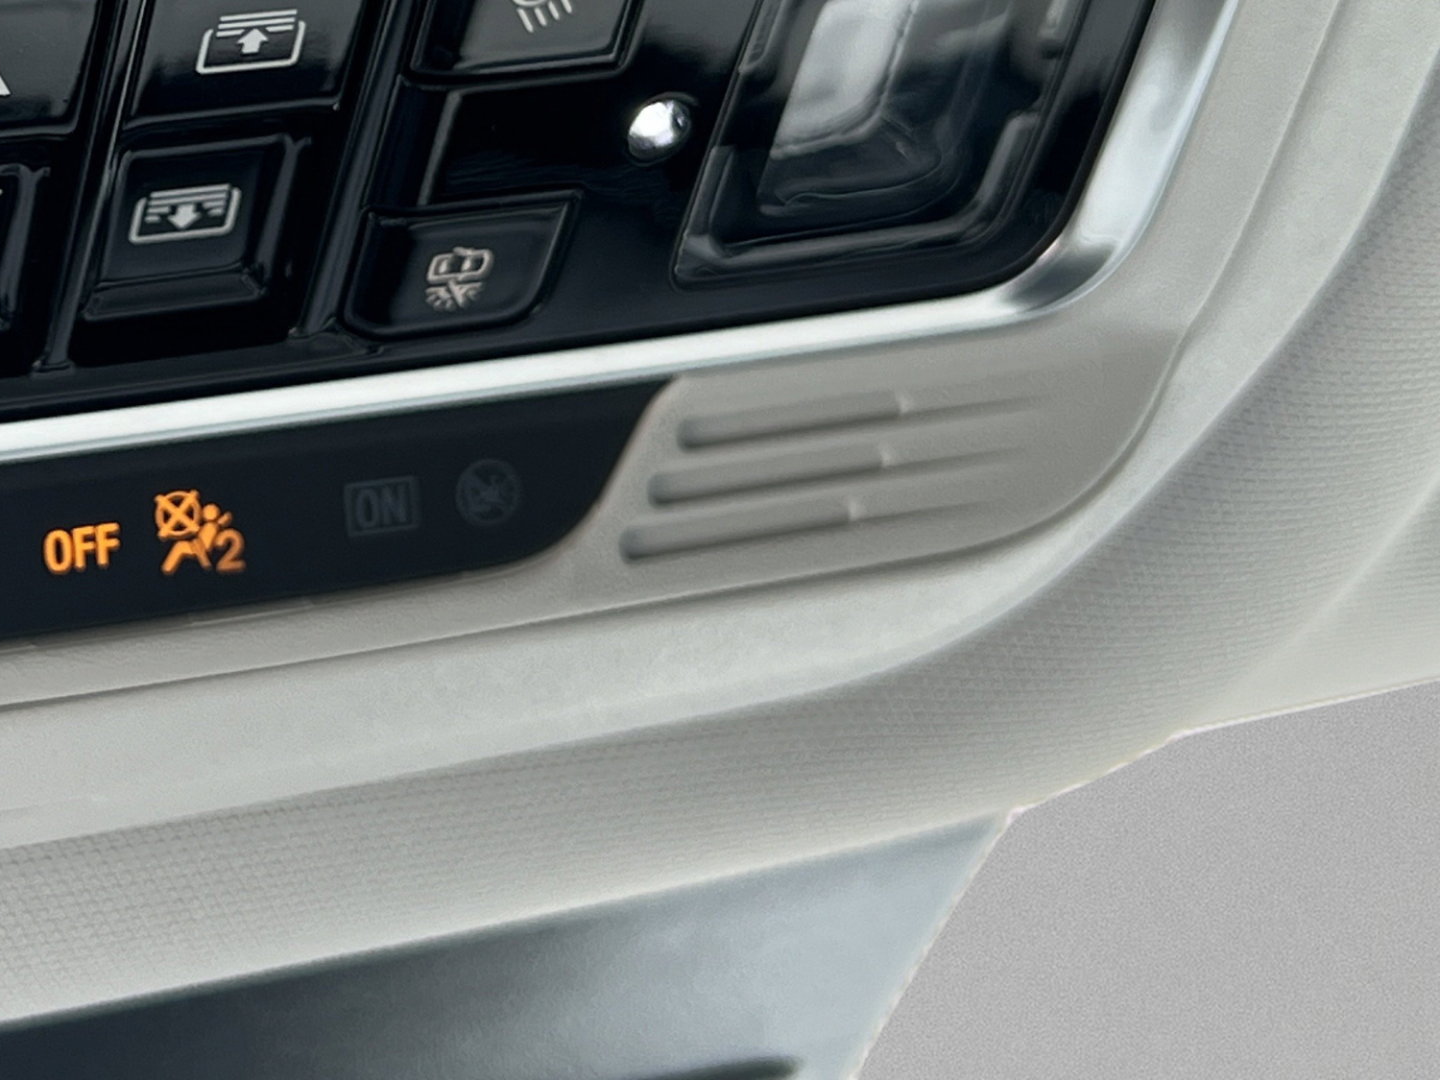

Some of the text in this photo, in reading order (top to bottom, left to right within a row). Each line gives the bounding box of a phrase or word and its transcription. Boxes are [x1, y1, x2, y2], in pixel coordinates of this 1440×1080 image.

[356, 484, 407, 528] ON
[43, 522, 120, 574] OFF
[217, 529, 246, 573] 2
